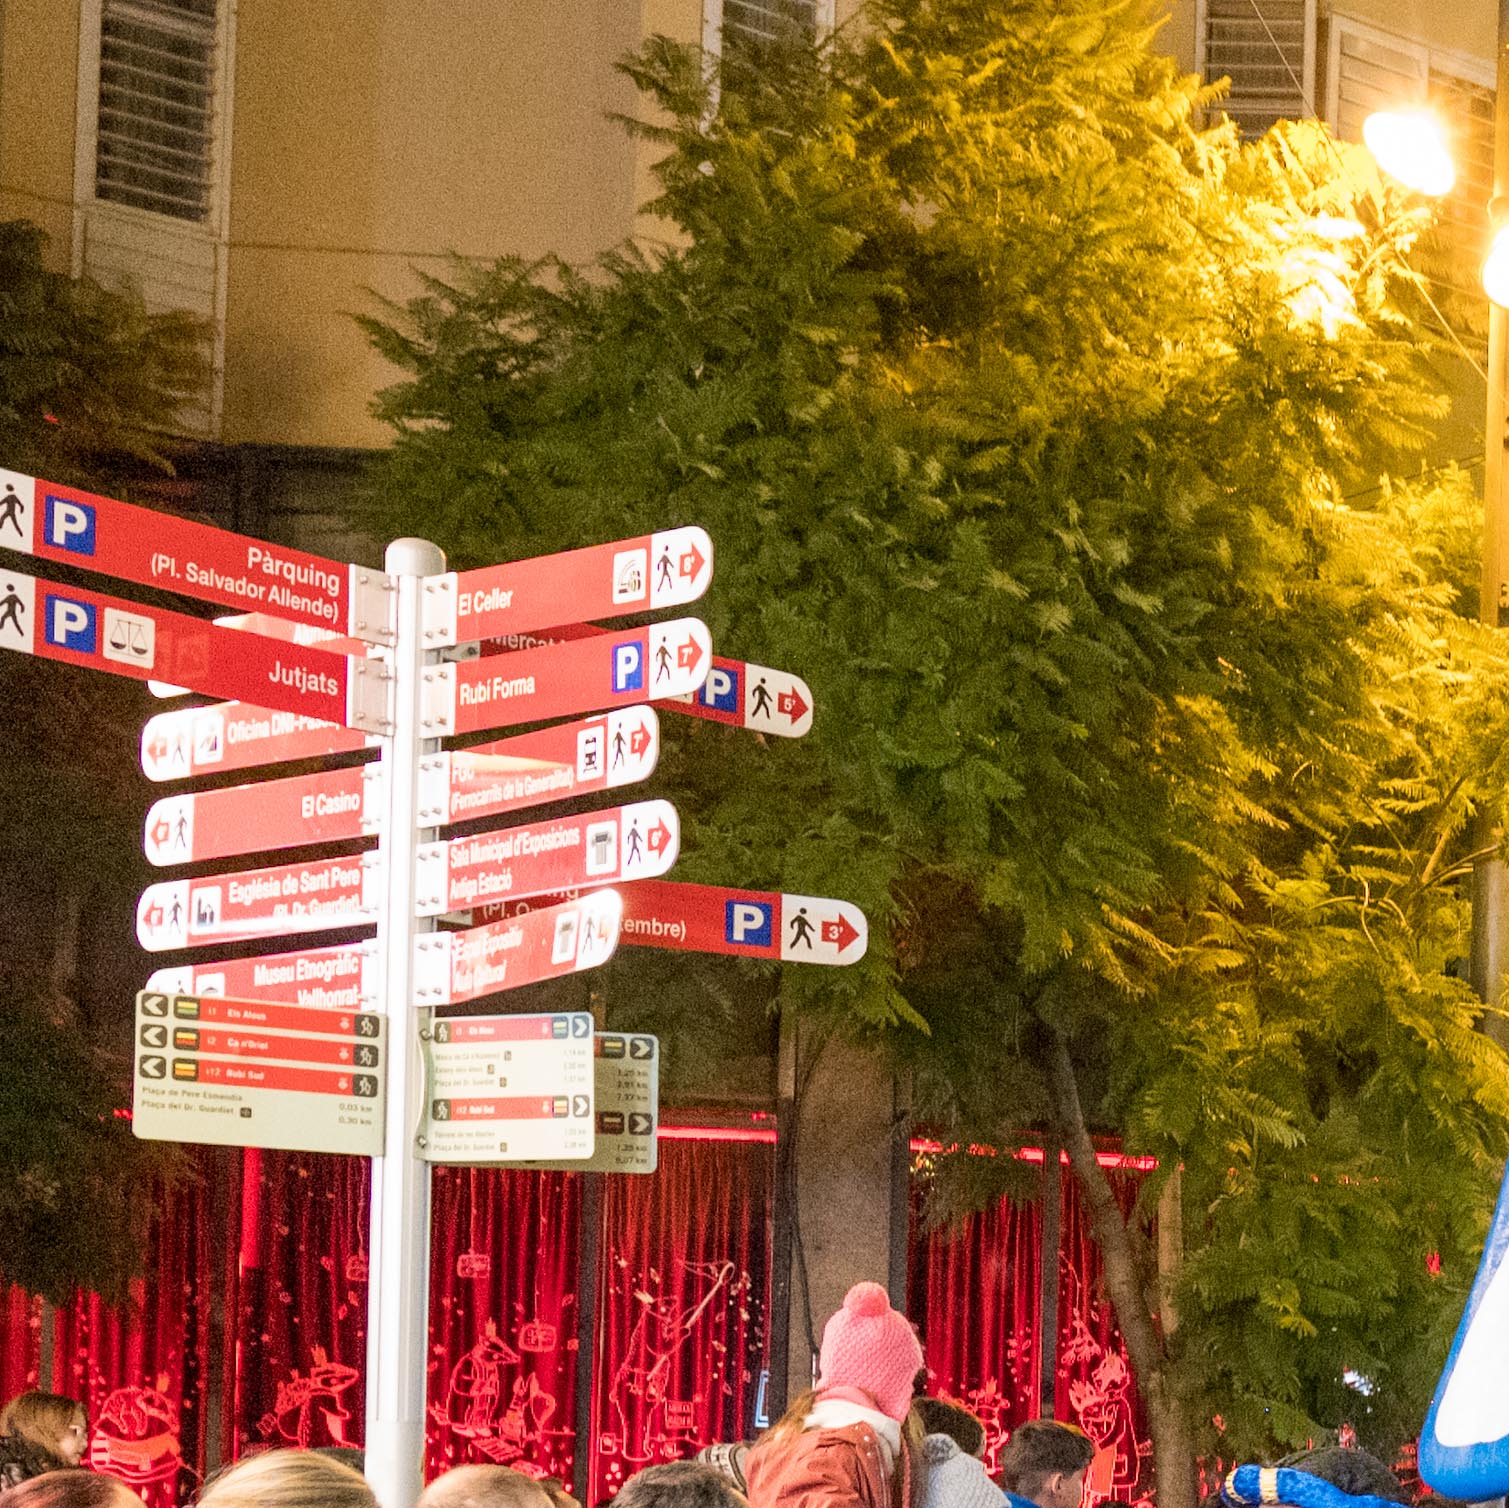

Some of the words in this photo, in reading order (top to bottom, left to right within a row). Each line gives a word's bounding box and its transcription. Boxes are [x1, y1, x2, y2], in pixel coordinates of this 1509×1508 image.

[53, 501, 87, 544] P
[151, 553, 180, 579] (Pl.
[186, 561, 265, 600] Salvador
[268, 586, 339, 624] Allende)
[247, 547, 340, 597] Pàrquing
[458, 594, 472, 616] El
[473, 587, 513, 613] Celler
[53, 600, 88, 644] P
[268, 660, 339, 696] Jutjats
[616, 646, 639, 689] P
[460, 677, 491, 705] Rubí
[493, 674, 535, 699] Forma
[705, 668, 732, 707] P
[228, 721, 270, 744] Oficina
[302, 796, 315, 818] El
[316, 791, 360, 816] Casino
[470, 837, 513, 863] Municipal
[229, 876, 281, 906] Església
[282, 873, 298, 895] de
[299, 868, 330, 893] Sant
[331, 866, 360, 889] Pere
[733, 903, 764, 942] P
[828, 925, 844, 940] 3'
[254, 963, 294, 987] Museu
